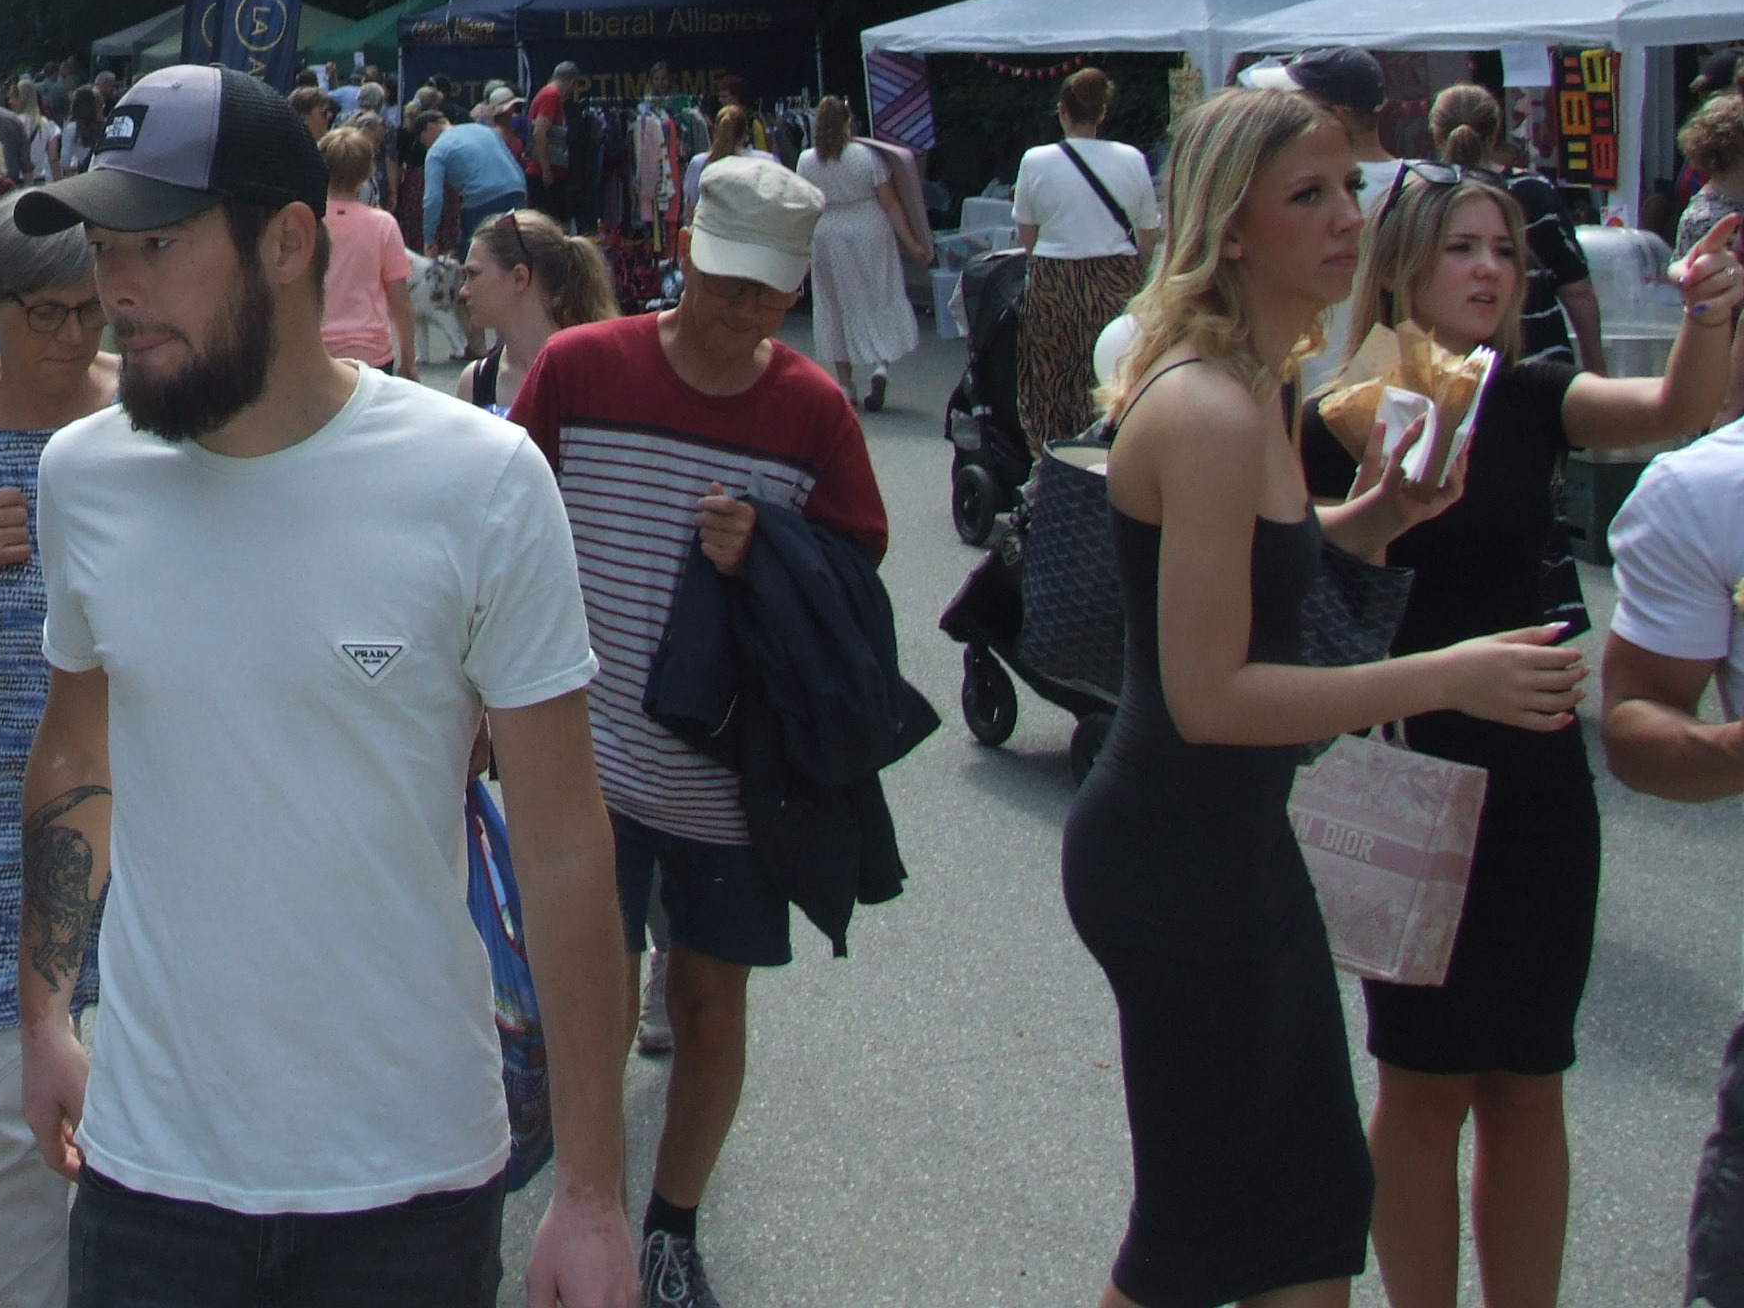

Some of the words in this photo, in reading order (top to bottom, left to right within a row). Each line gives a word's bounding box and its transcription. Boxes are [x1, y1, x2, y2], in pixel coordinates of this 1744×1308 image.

[250, 6, 272, 37] LA
[564, 9, 655, 37] Liberal
[667, 7, 774, 34] Alliance
[354, 649, 390, 658] PRADA
[1320, 820, 1375, 864] DIOR
